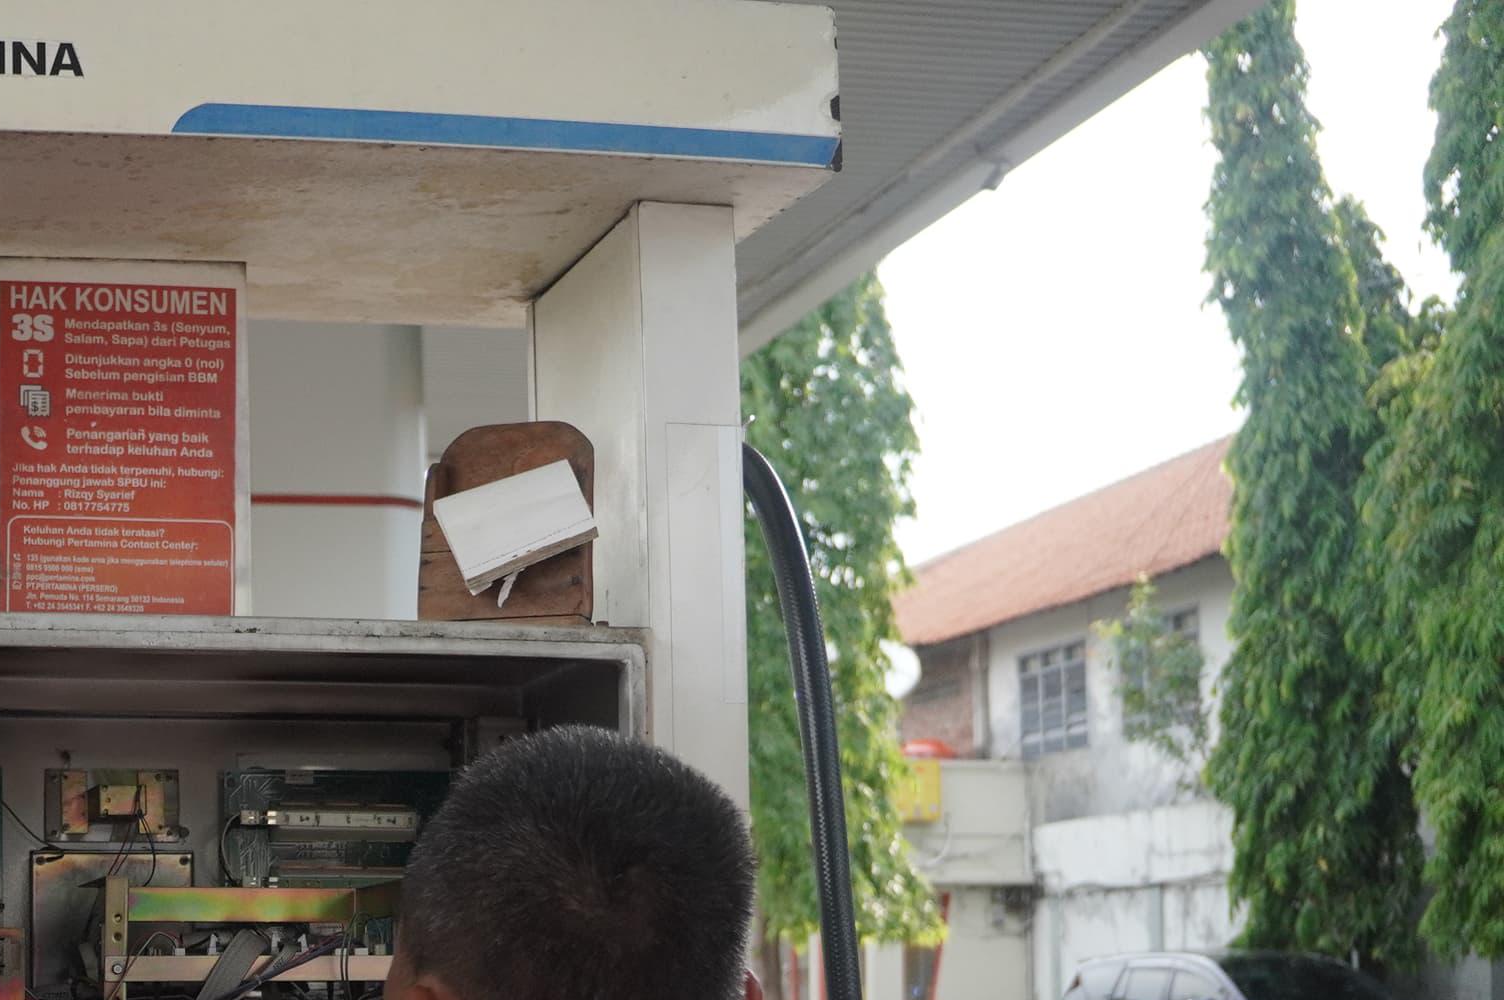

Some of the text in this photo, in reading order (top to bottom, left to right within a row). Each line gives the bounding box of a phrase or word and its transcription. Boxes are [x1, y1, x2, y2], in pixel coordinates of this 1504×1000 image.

[10, 286, 228, 316] HAK KONSUMEN
[11, 313, 55, 342] 3S
[64, 318, 231, 336] Mendapatkan 3s (Senyum,
[64, 333, 231, 351] Salam, Sapa) dari Petugas
[65, 353, 225, 371] Ditunjukkan angka 0 (nol)
[65, 368, 218, 384] Sebelum pengisian BBM
[65, 388, 164, 402] Menerima bukti
[65, 405, 222, 419] pembayaran bila diminta
[148, 432, 179, 445] yang
[182, 432, 209, 443] baik
[66, 444, 214, 458] terhadap keluhan Anda
[12, 463, 225, 479] Jika hak Anda tidak terpenuhi, hubungi:
[12, 475, 167, 489] Penanggung jawab SPBU ini:
[12, 488, 44, 498] Nama
[64, 490, 94, 501] Rizqy
[96, 490, 135, 501] Syarief
[12, 500, 30, 510] No.
[33, 500, 50, 510] HP
[24, 525, 64, 535] Keluhan
[66, 526, 93, 536] Anda
[94, 527, 120, 537] tidak
[24, 537, 65, 548] Hubungi
[67, 538, 118, 548] Pertamina
[120, 540, 159, 549] Contact
